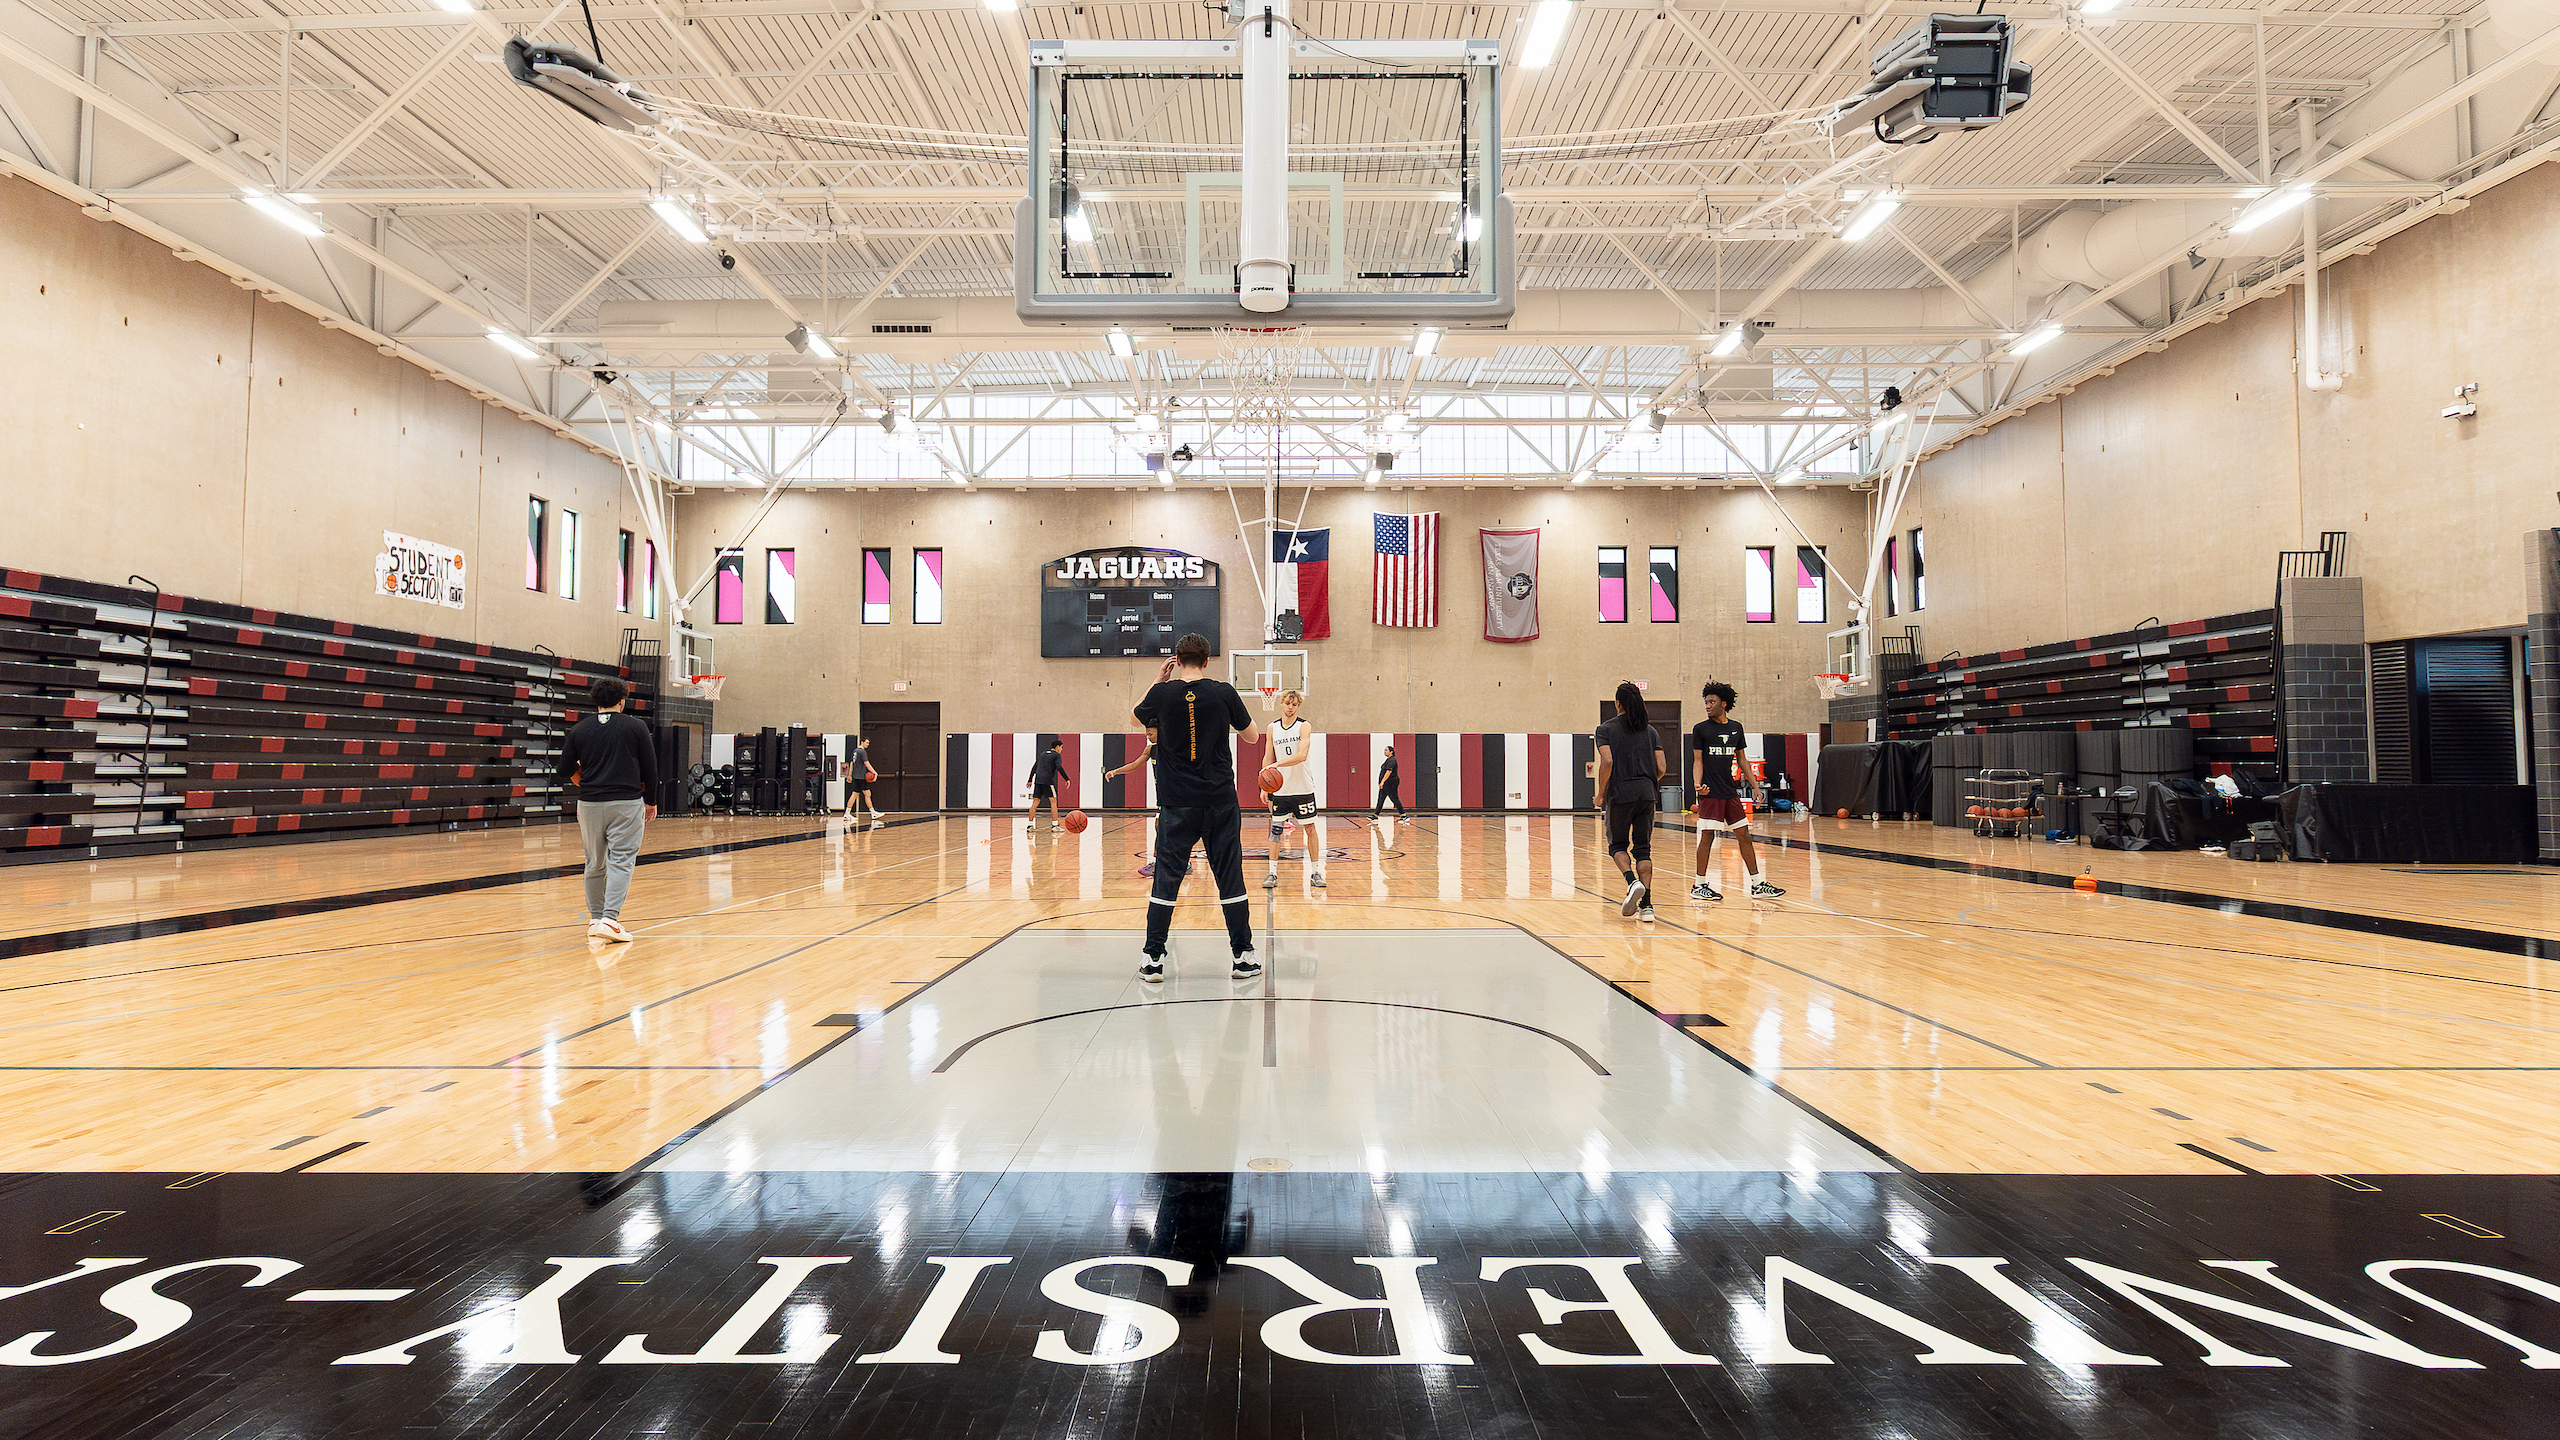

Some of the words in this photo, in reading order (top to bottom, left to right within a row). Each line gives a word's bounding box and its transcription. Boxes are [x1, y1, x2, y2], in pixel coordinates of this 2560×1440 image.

[389, 546, 452, 580] STUDENT
[1056, 556, 1205, 580] JAGUARS
[401, 574, 444, 601] SECTION
[1153, 592, 1173, 600] Guests
[1121, 614, 1139, 622] period
[1285, 745, 1292, 756] 0
[1750, 763, 1759, 771] G
[1298, 801, 1316, 815] 55
